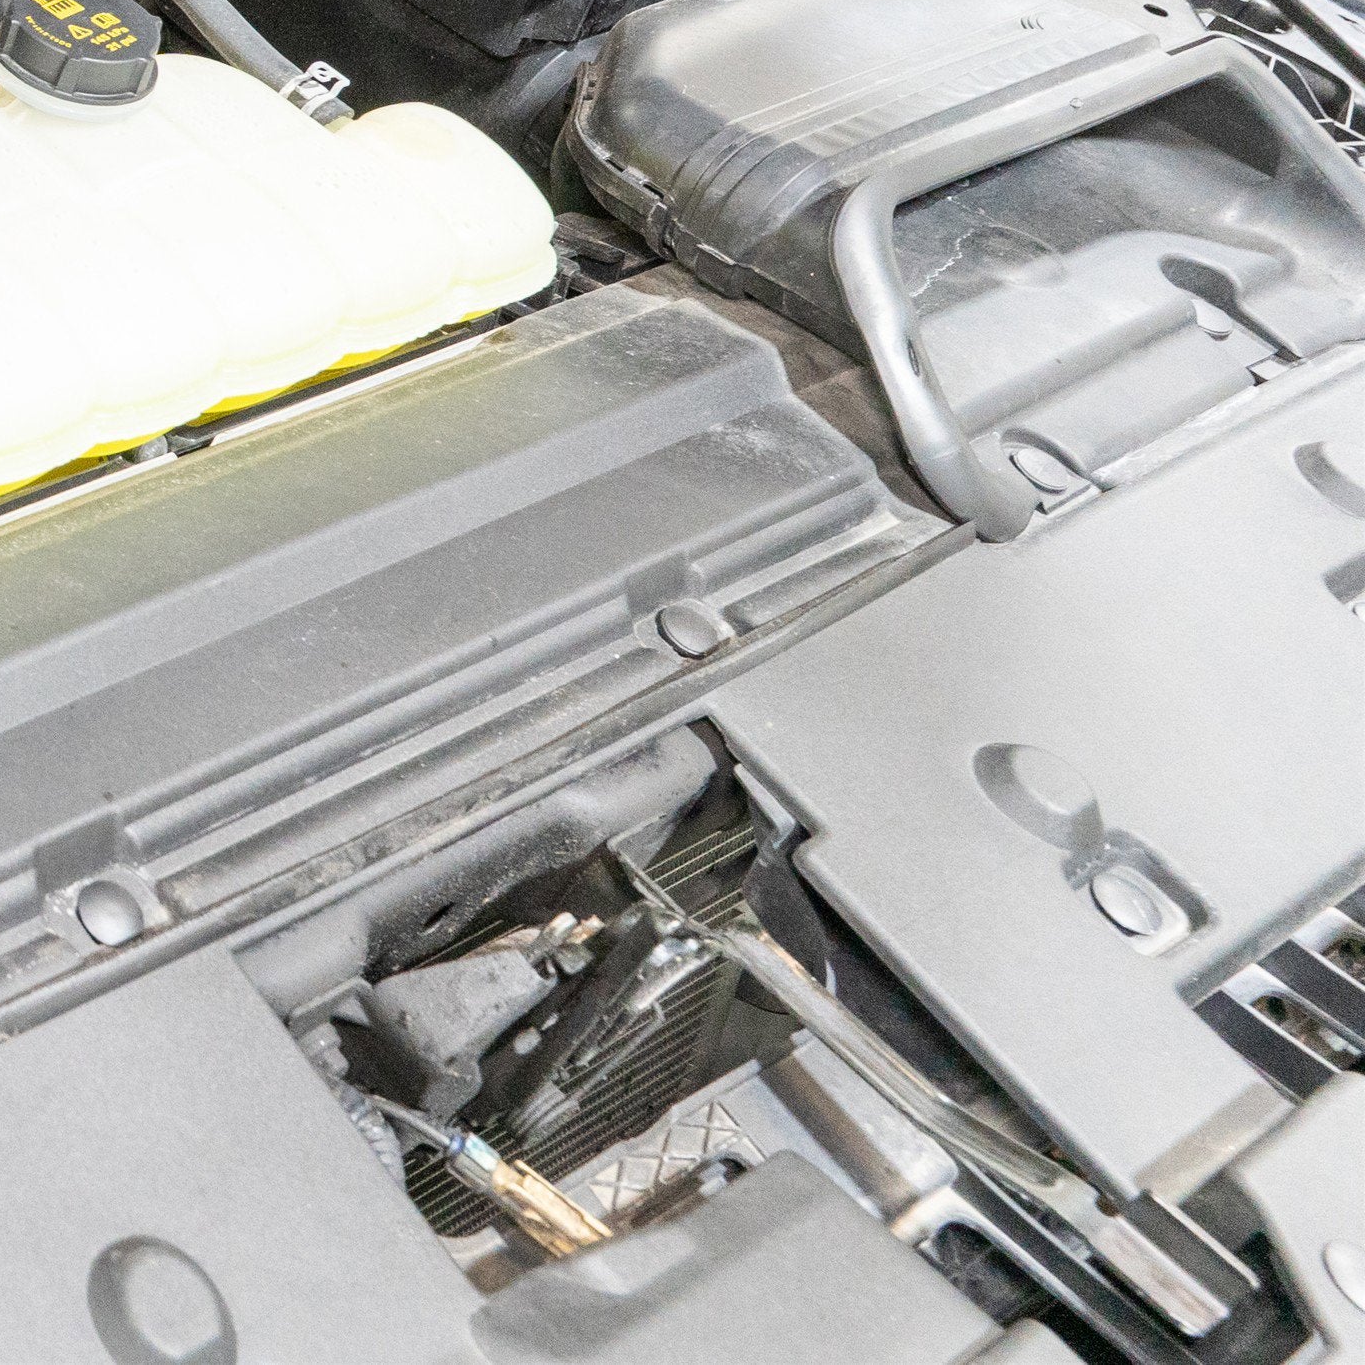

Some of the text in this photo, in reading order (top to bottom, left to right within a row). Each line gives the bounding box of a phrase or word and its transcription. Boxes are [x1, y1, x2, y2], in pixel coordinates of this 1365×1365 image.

[107, 26, 130, 38] kPa
[106, 35, 138, 52] 21 psi
